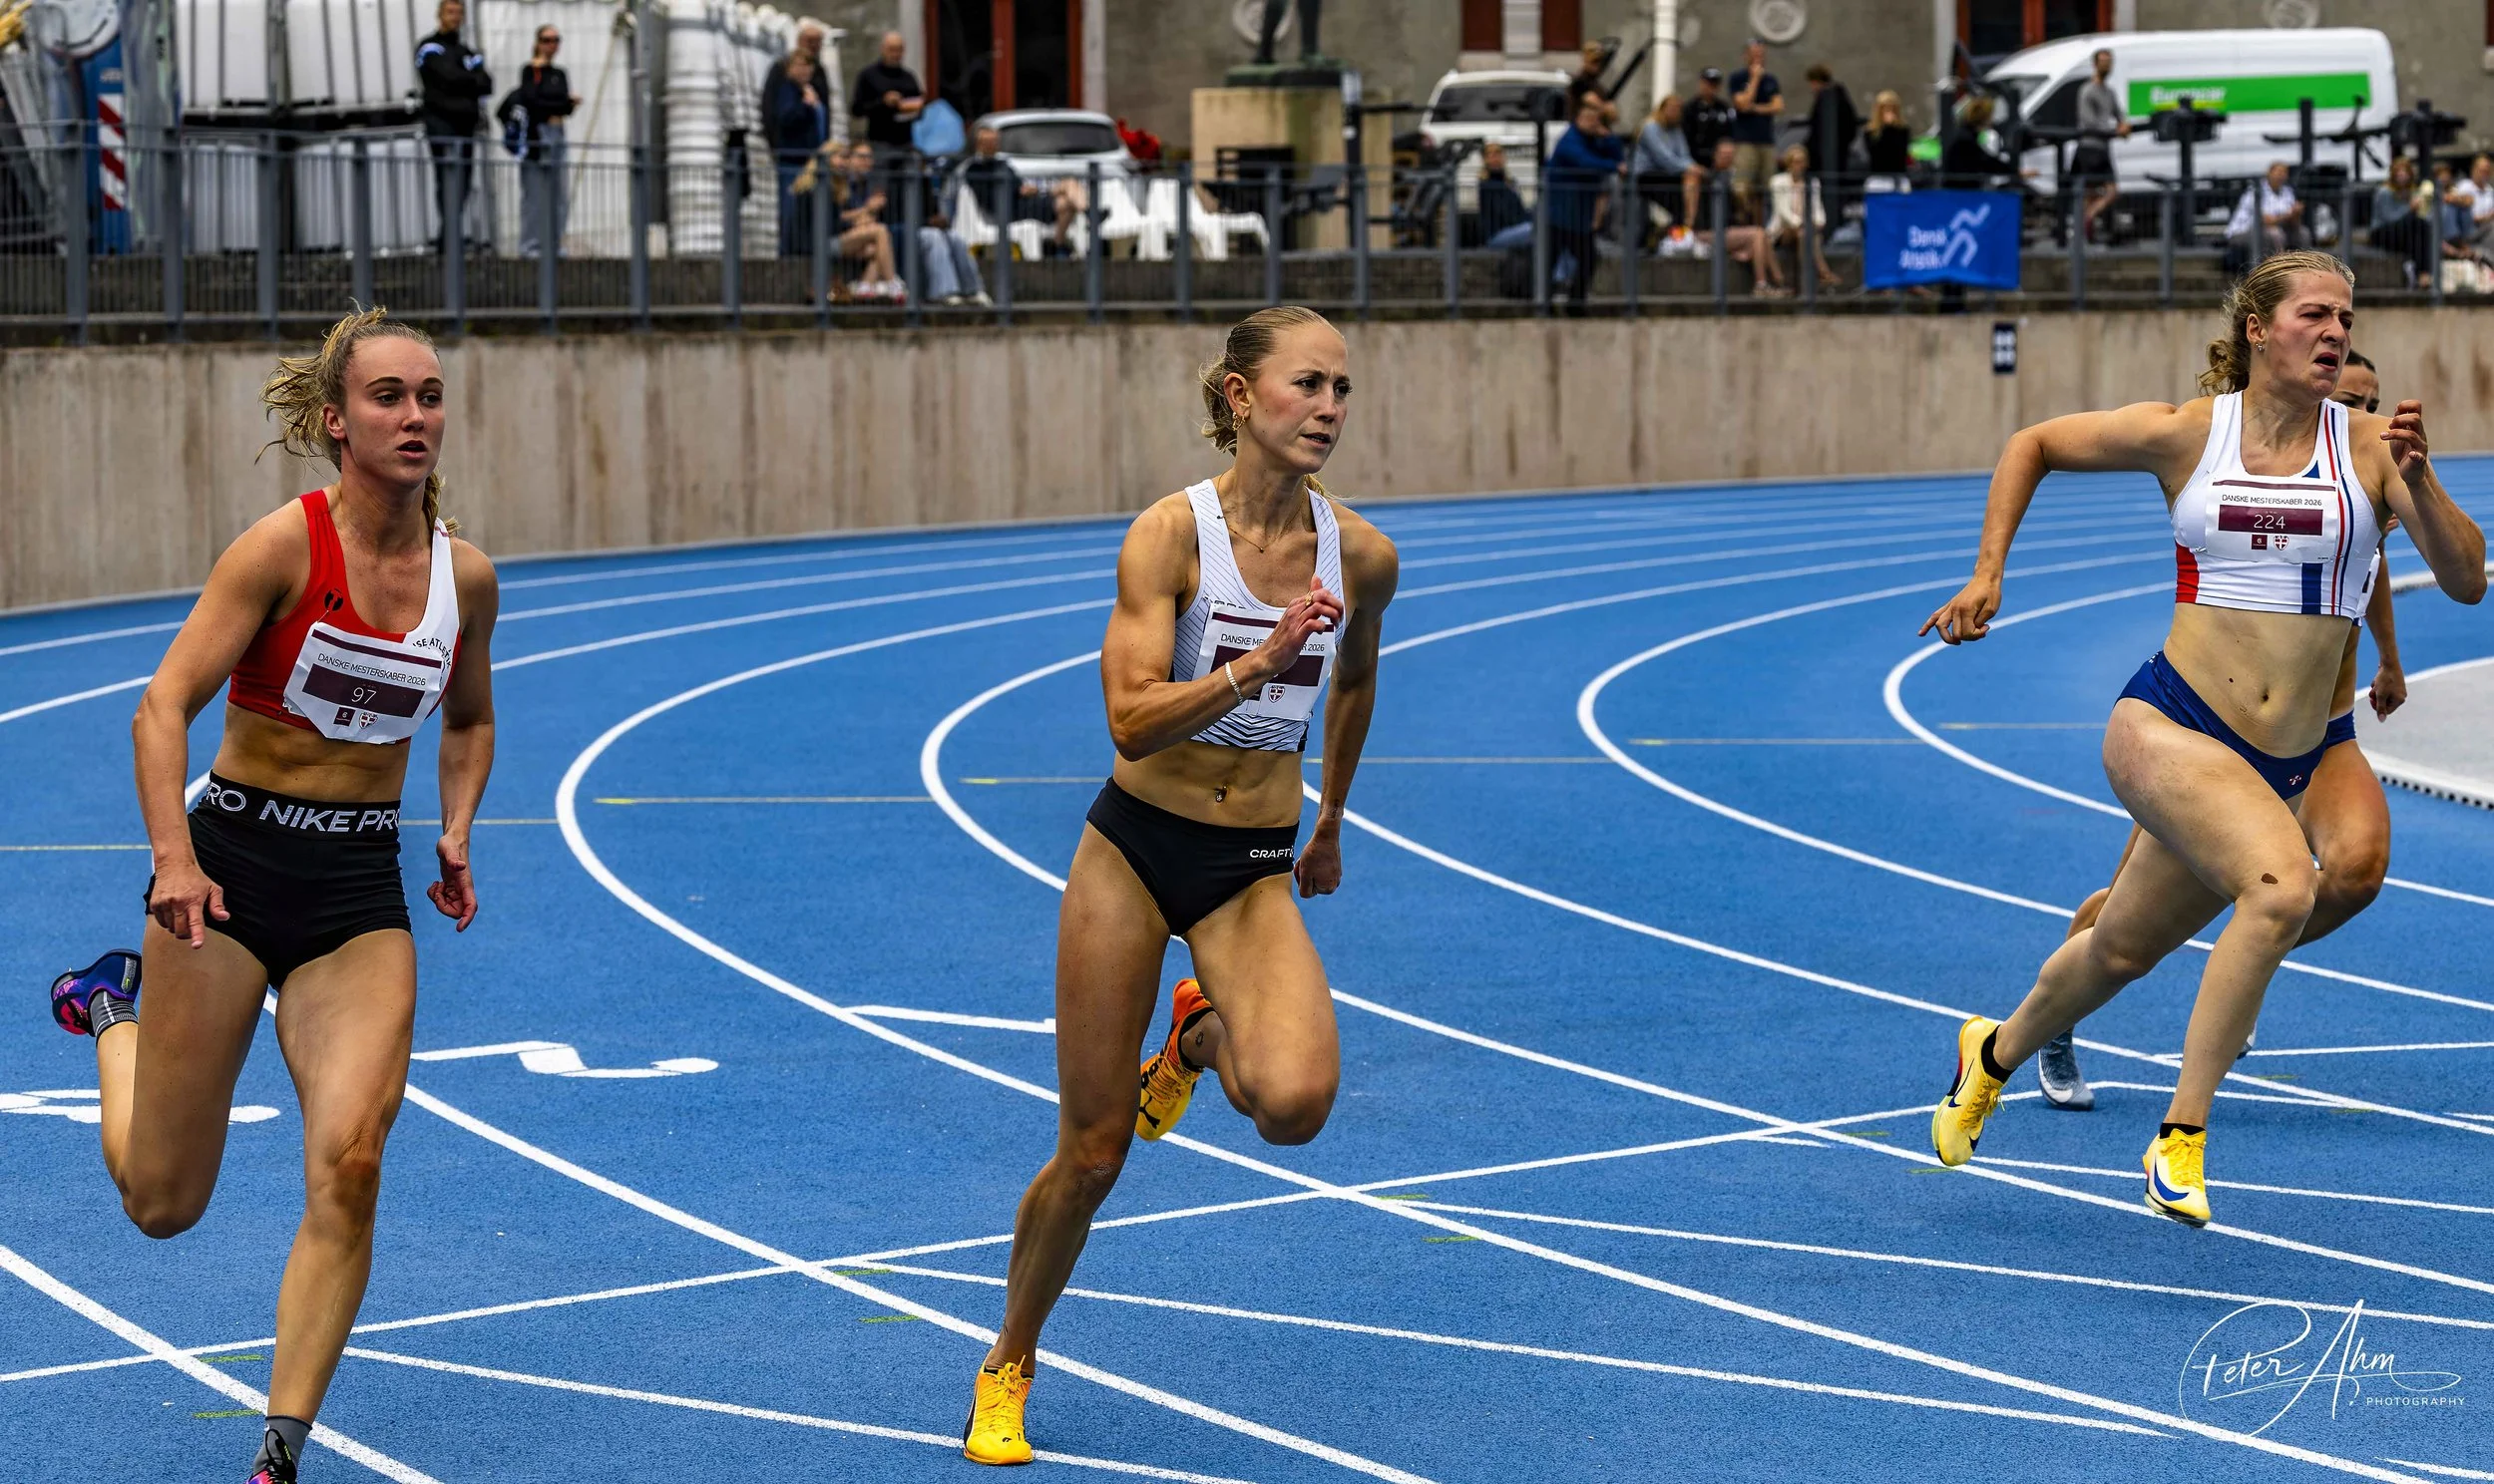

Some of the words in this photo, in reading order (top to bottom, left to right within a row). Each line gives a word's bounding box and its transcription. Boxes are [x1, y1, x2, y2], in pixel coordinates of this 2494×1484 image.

[2222, 494, 2249, 503] DANSKE
[2250, 497, 2302, 506] MESTERSKABER
[2254, 514, 2286, 530] 224
[1220, 633, 1252, 646] DANSKE
[1308, 643, 1325, 652] 2026
[317, 652, 350, 670] DANSKE
[350, 663, 406, 683] MESTERSKABER
[406, 675, 427, 686] 2026
[351, 686, 377, 705] 97
[258, 799, 357, 833] NIKE
[356, 809, 400, 833] PR
[1249, 848, 1292, 859] CRAFT
